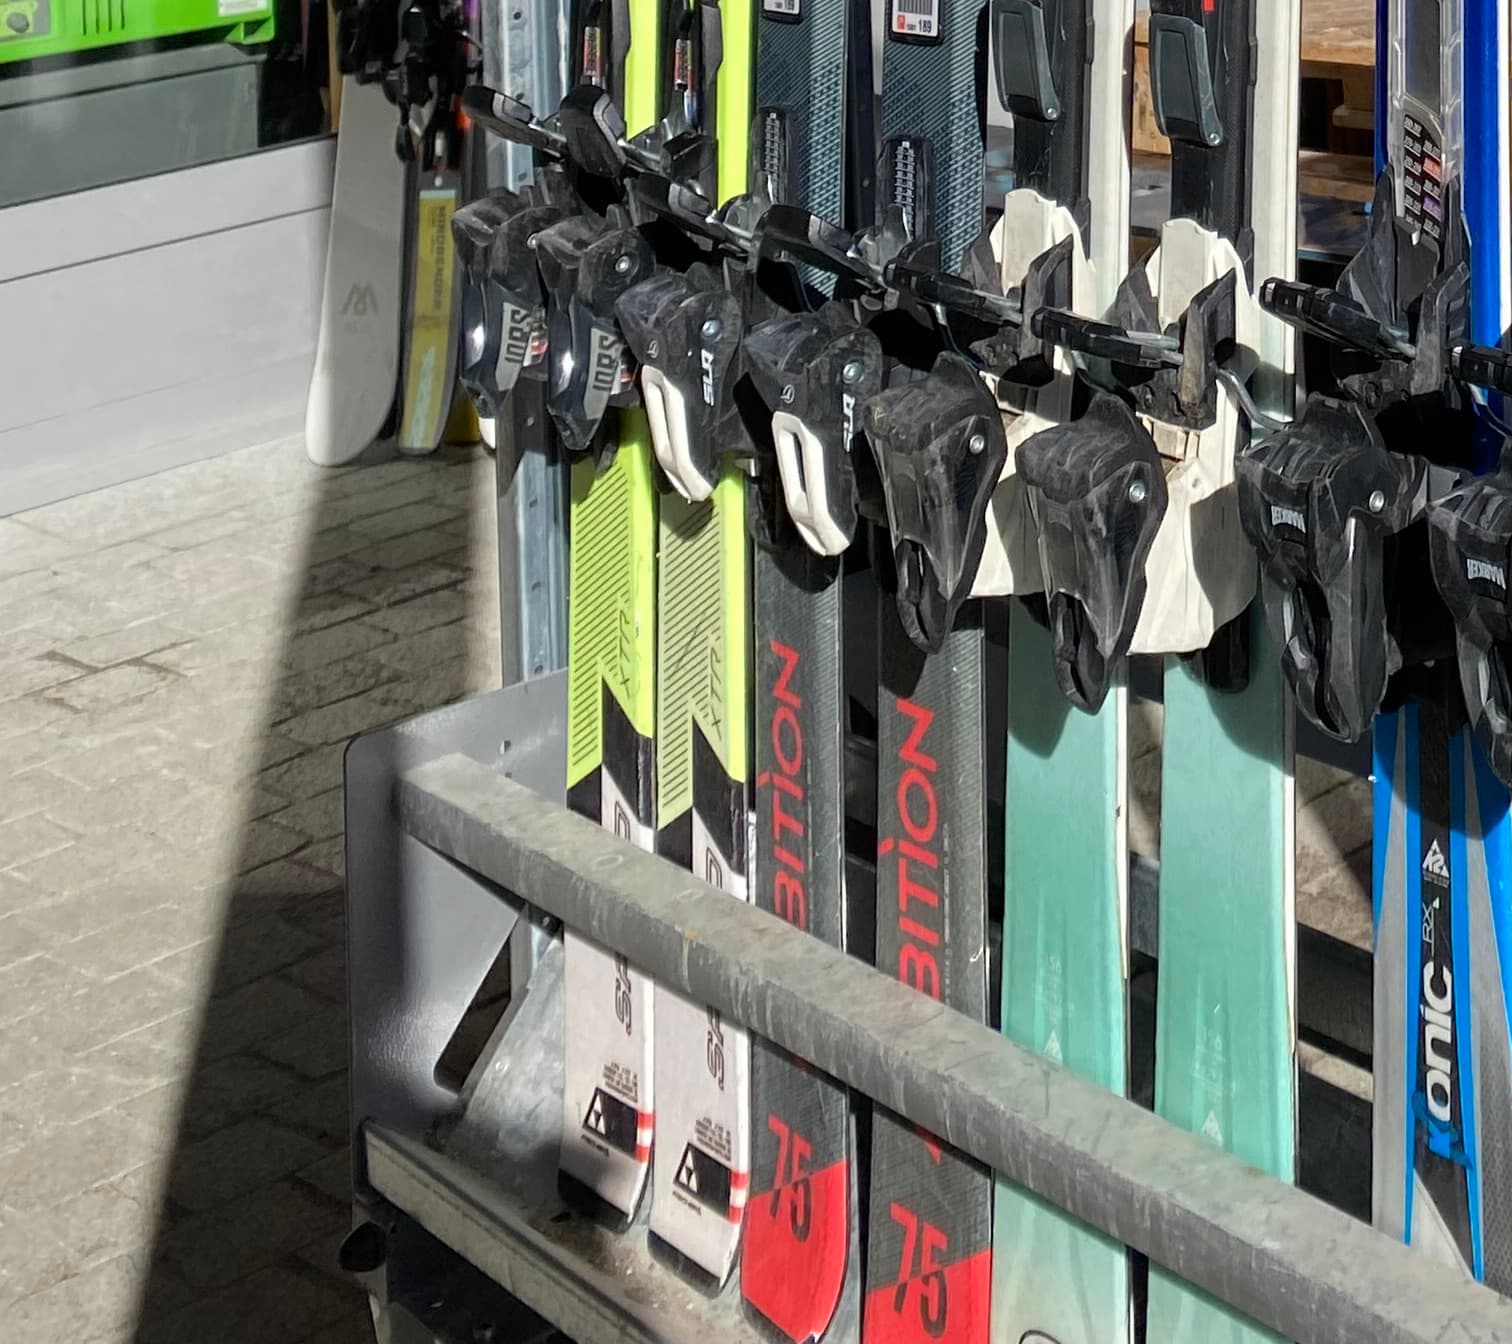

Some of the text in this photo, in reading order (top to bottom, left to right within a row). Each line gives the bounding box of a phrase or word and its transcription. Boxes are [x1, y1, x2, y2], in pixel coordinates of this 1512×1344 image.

[918, 20, 932, 33] 189
[701, 349, 714, 406] SLR
[620, 610, 630, 700] XTR
[710, 647, 721, 742] XTR
[757, 640, 807, 931] BITION
[878, 698, 940, 1000] BITION
[1422, 839, 1449, 877] K2
[1422, 902, 1434, 943] RX
[768, 1114, 813, 1243] 75
[890, 1202, 948, 1338] 75
